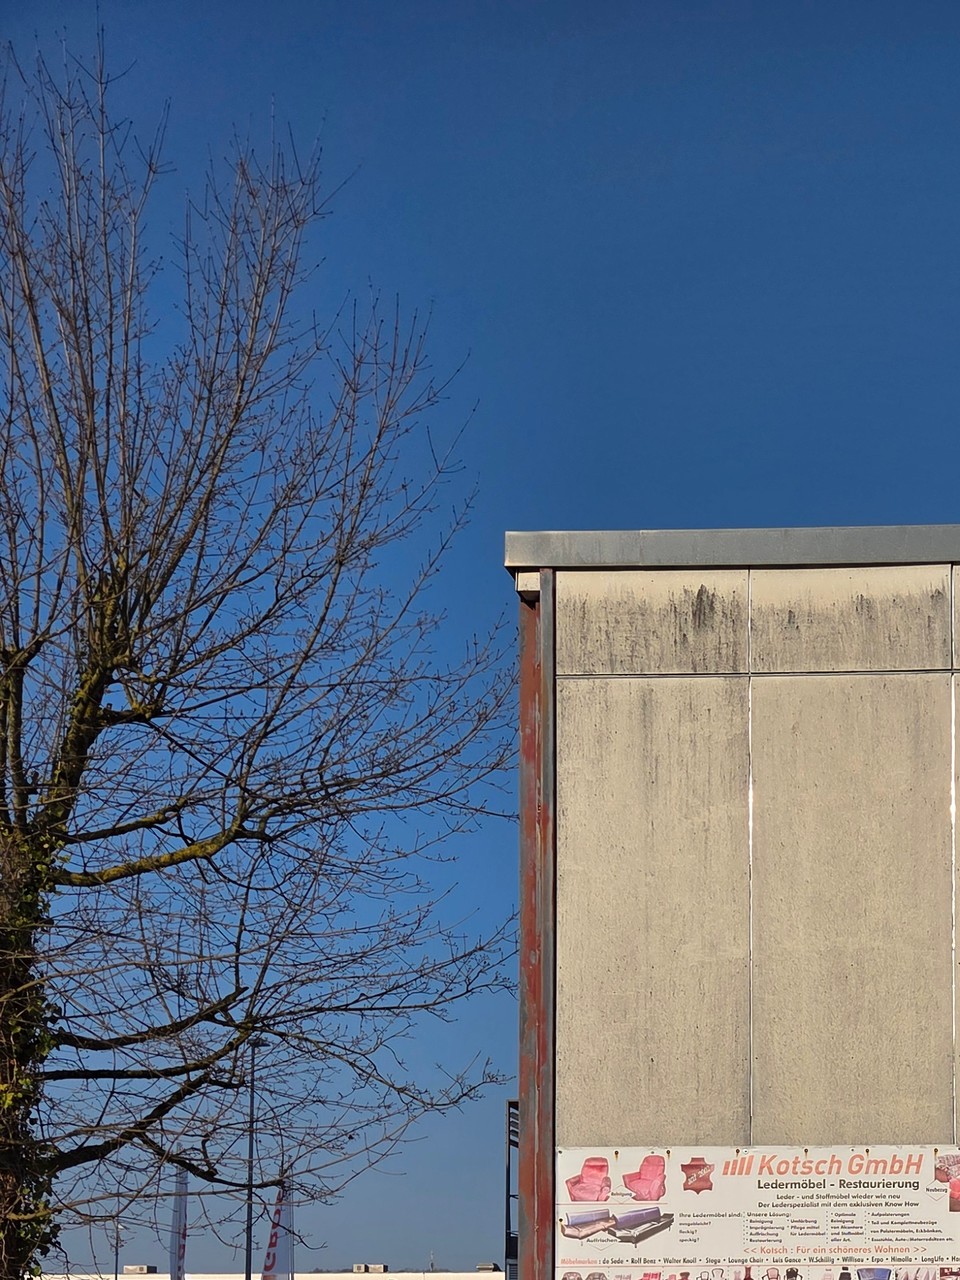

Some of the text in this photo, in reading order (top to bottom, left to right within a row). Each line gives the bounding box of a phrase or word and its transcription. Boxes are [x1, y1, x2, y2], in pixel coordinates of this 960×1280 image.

[757, 1153, 924, 1176] Kotsch GmbH
[757, 1179, 826, 1190] Ledermöbel
[838, 1179, 920, 1191] Restaurierung
[815, 1192, 850, 1200] Stoffmöbel
[771, 1201, 819, 1209] Lederspezialist
[760, 1246, 788, 1254] Kotsch
[796, 1246, 811, 1254] Für
[813, 1246, 826, 1254] ein
[829, 1245, 872, 1254] schöneres
[874, 1245, 911, 1253] Wohnen
[728, 1256, 749, 1265] Lounge
[749, 1256, 764, 1264] Chair
